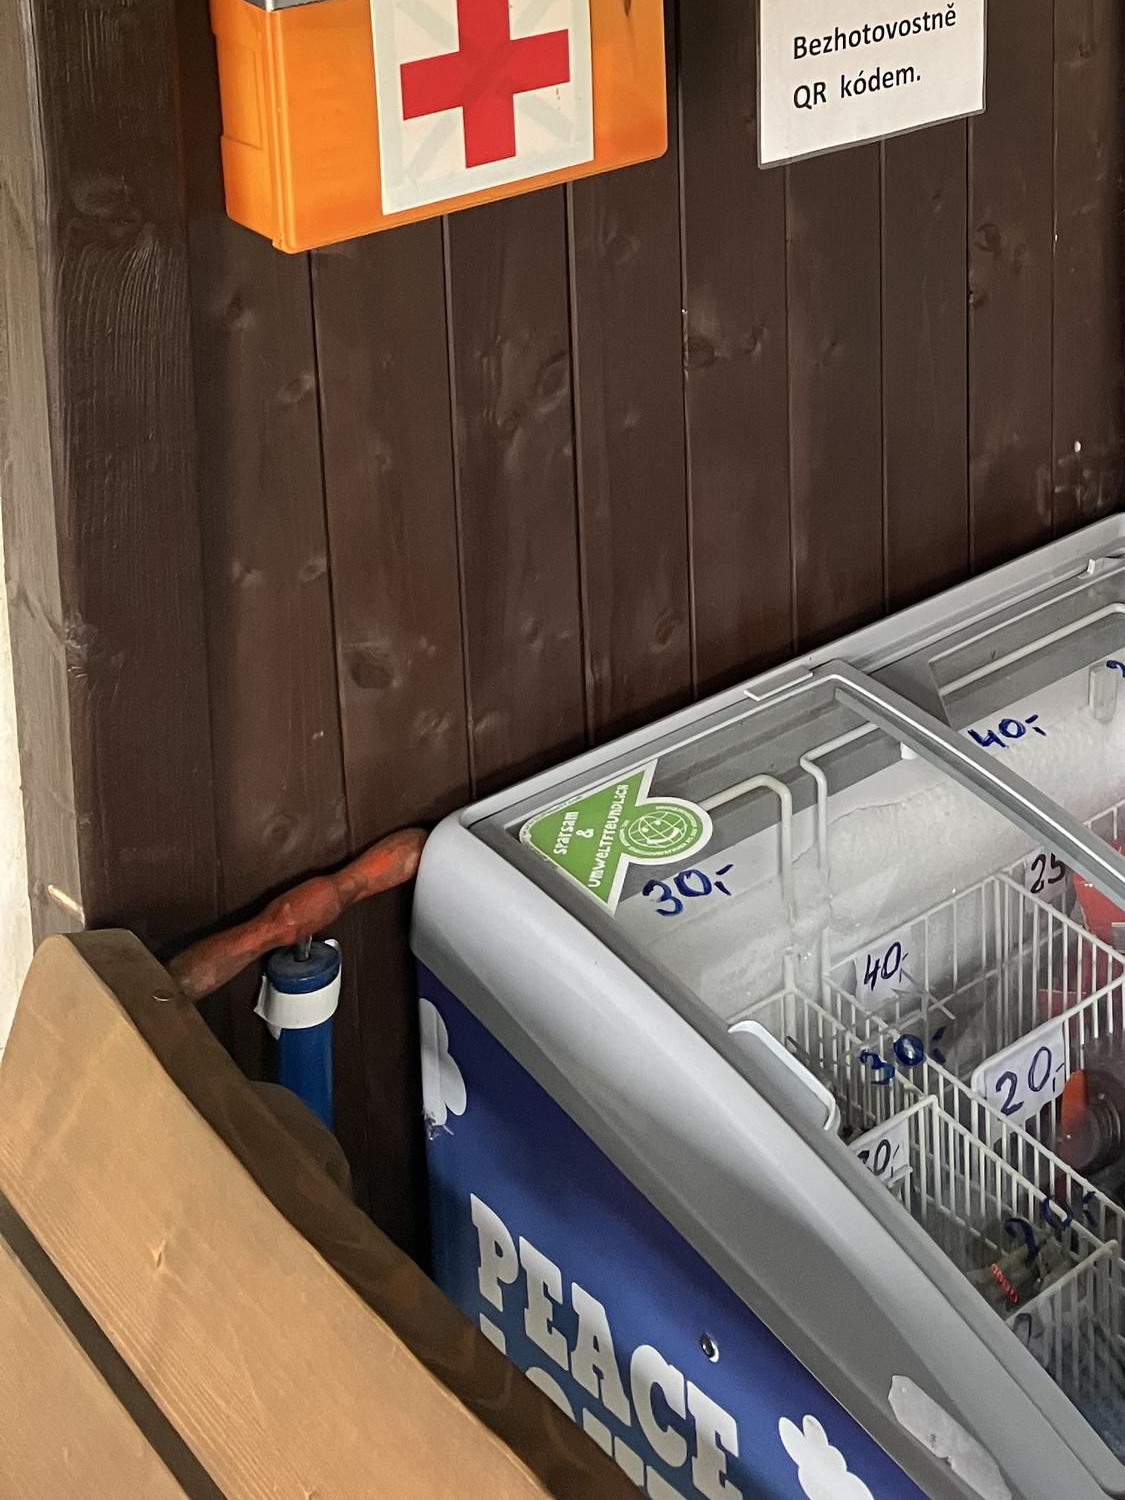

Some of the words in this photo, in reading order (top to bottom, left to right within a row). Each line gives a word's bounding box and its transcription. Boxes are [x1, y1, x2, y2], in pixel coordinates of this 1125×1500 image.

[792, 3, 957, 59] Bezhotovostně
[793, 81, 827, 109] QR
[840, 65, 921, 99] kódem.
[576, 828, 594, 839] &
[470, 1192, 743, 1500] PEACE
